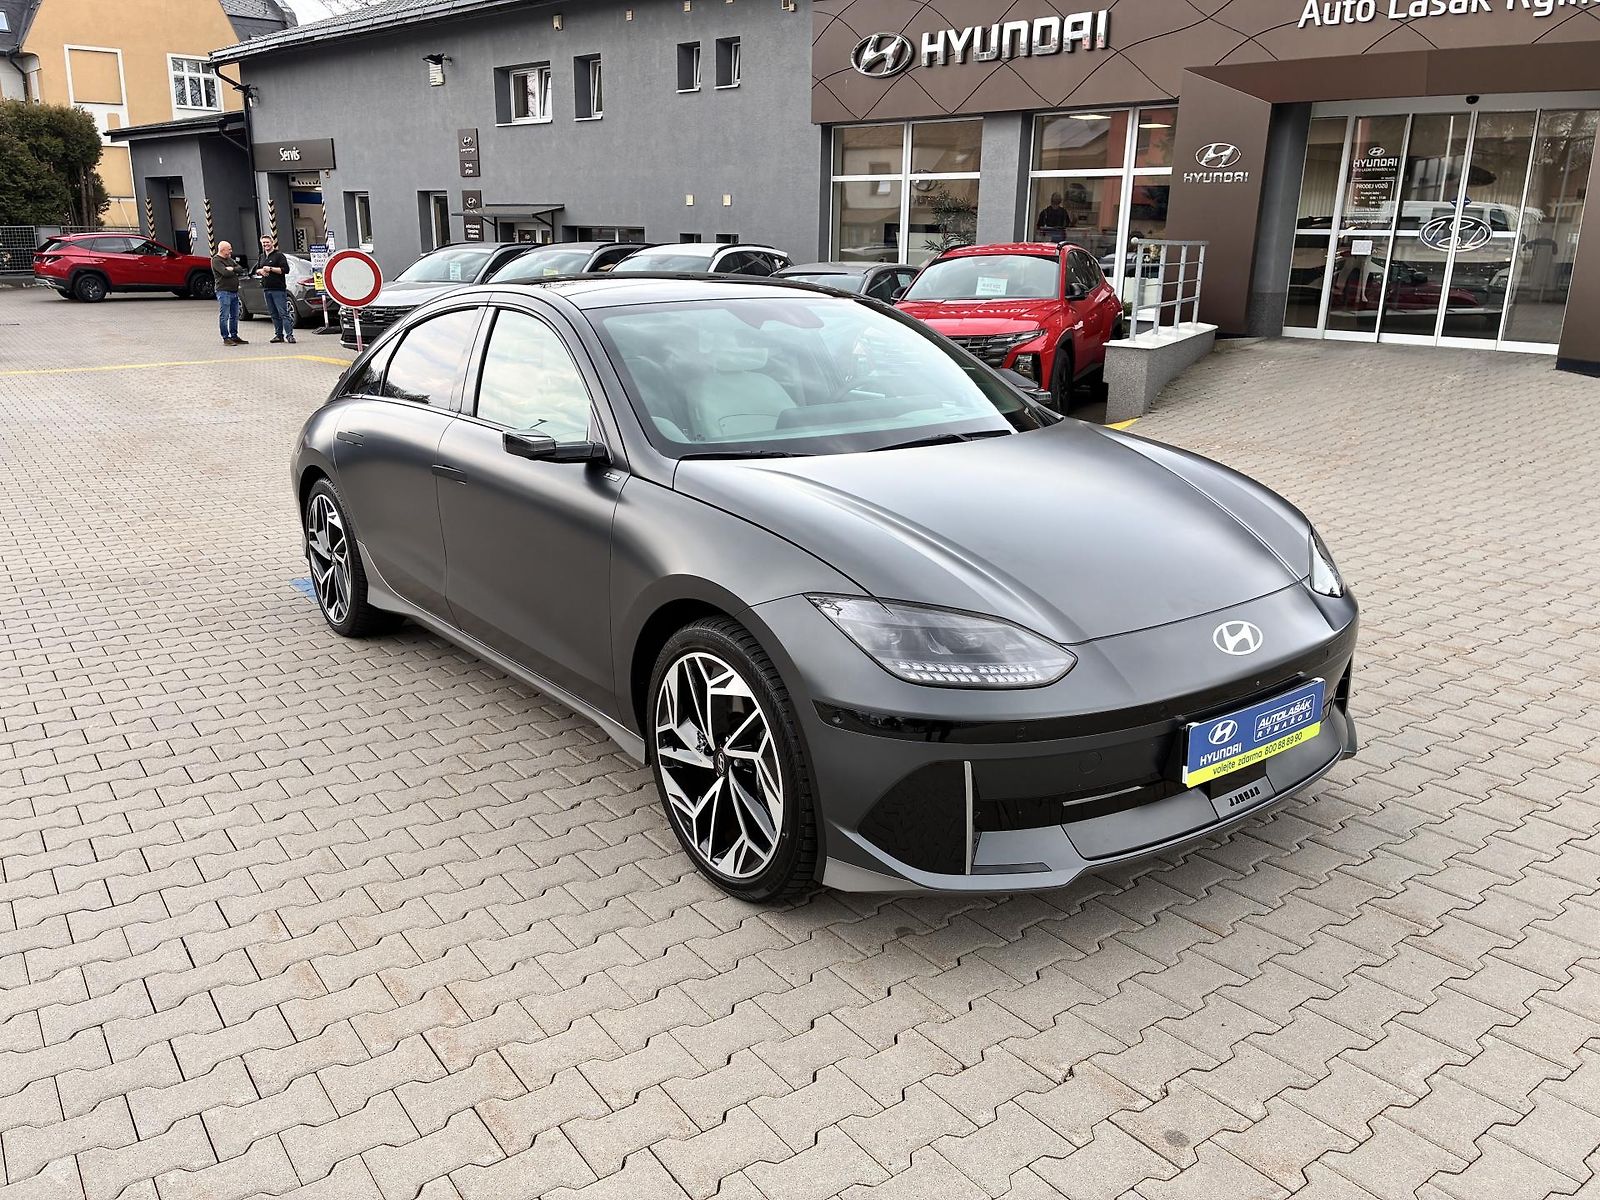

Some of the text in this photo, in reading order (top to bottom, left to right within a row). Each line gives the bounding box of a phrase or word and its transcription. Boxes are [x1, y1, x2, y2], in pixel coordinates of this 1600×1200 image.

[1297, 0, 1377, 28] Auto
[921, 10, 1109, 67] HYUNDAI
[279, 146, 301, 161] Servis
[1352, 157, 1398, 168] HYUNDAI
[1183, 171, 1249, 183] HYUNDAI
[1200, 742, 1242, 766] HYUNDAI
[1212, 761, 1236, 775] volejte
[1238, 750, 1263, 766] zdarma
[1264, 743, 1278, 756] 800
[1294, 731, 1303, 743] 90
